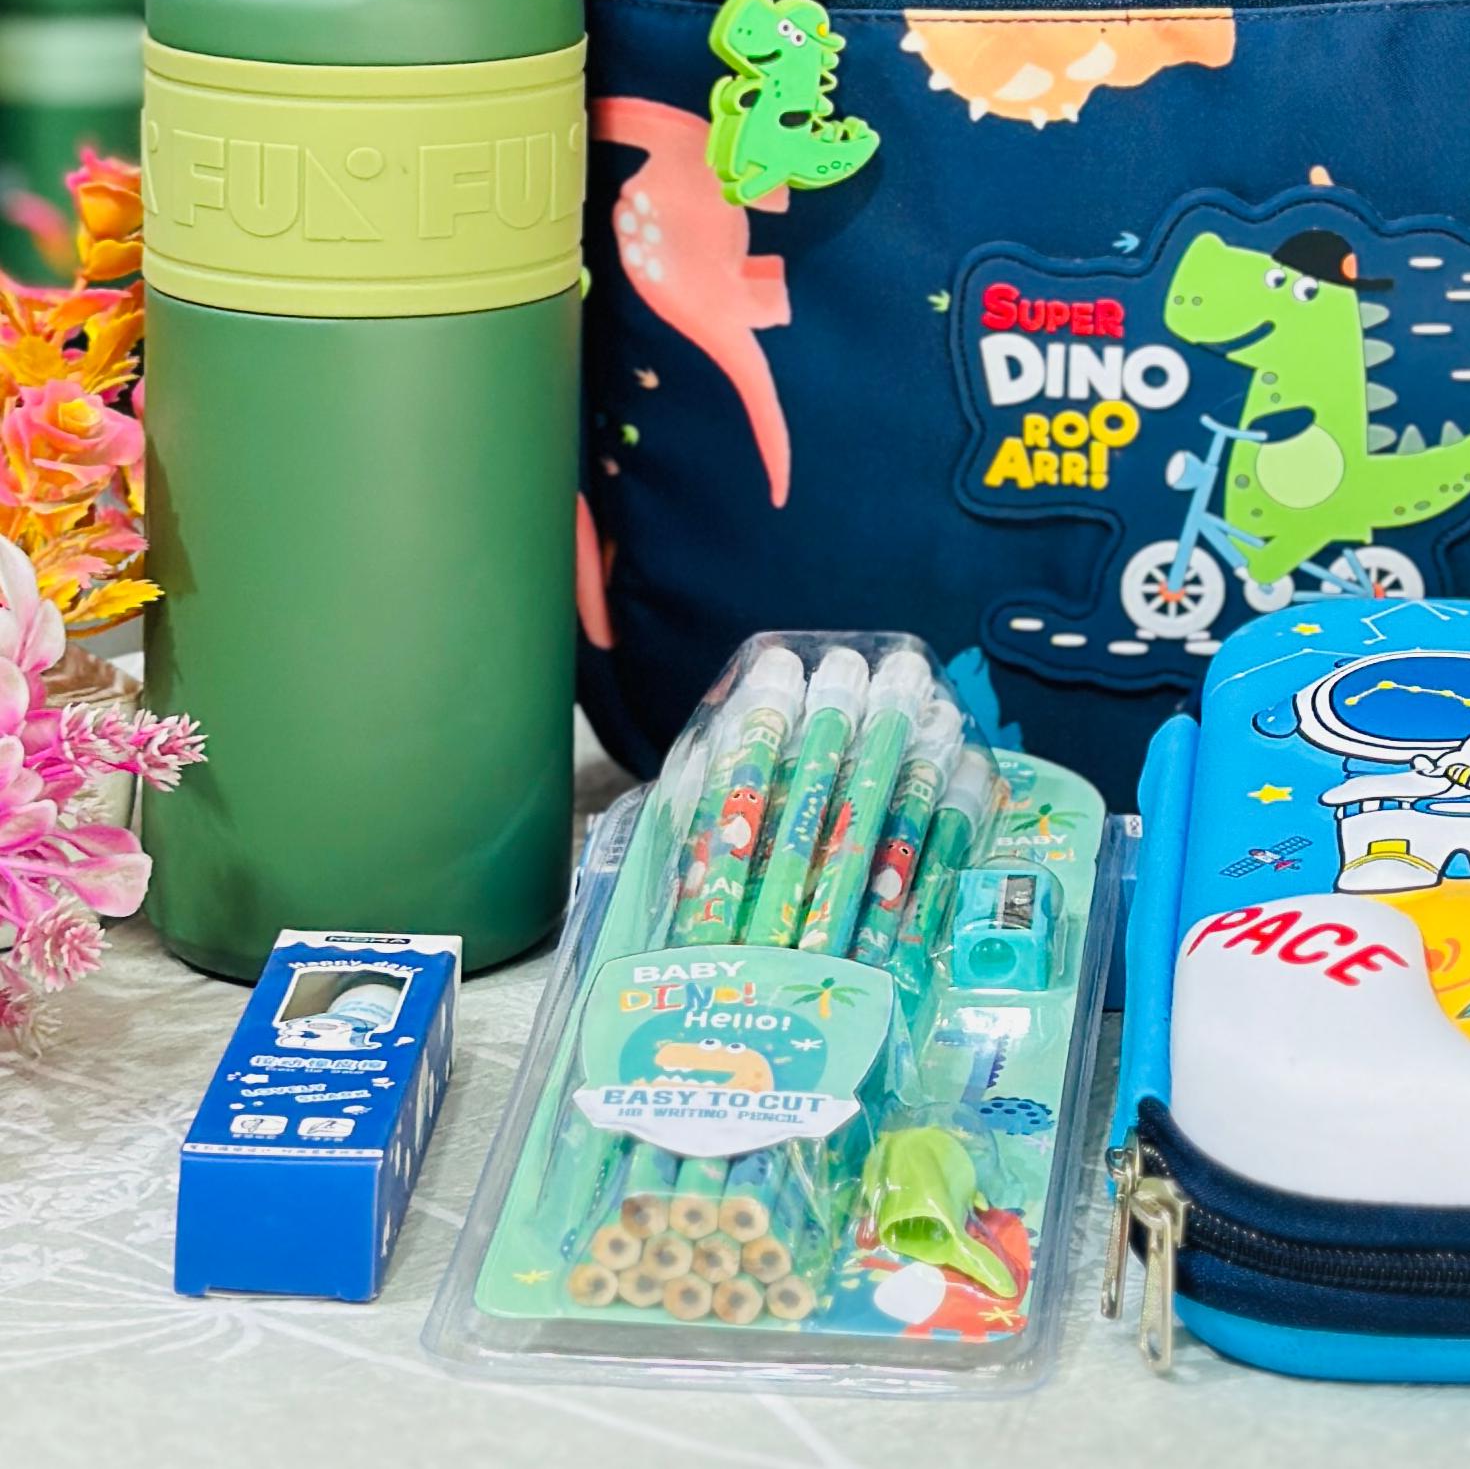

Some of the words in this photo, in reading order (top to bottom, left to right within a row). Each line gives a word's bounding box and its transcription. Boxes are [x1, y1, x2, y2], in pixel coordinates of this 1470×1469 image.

[981, 282, 1126, 339] SUPER
[980, 333, 1190, 410] DINO
[1023, 399, 1140, 448] ROO
[983, 437, 1109, 490] ARR!
[1187, 906, 1410, 986] PACE
[633, 960, 746, 983] BABY
[618, 982, 758, 1012] DINO!
[684, 1010, 792, 1031] Hello!
[603, 1089, 699, 1107] EASY
[708, 1092, 750, 1108] TO
[758, 1093, 827, 1113] CUT
[653, 1107, 728, 1120] WRITING
[737, 1110, 804, 1124] PENCIL
